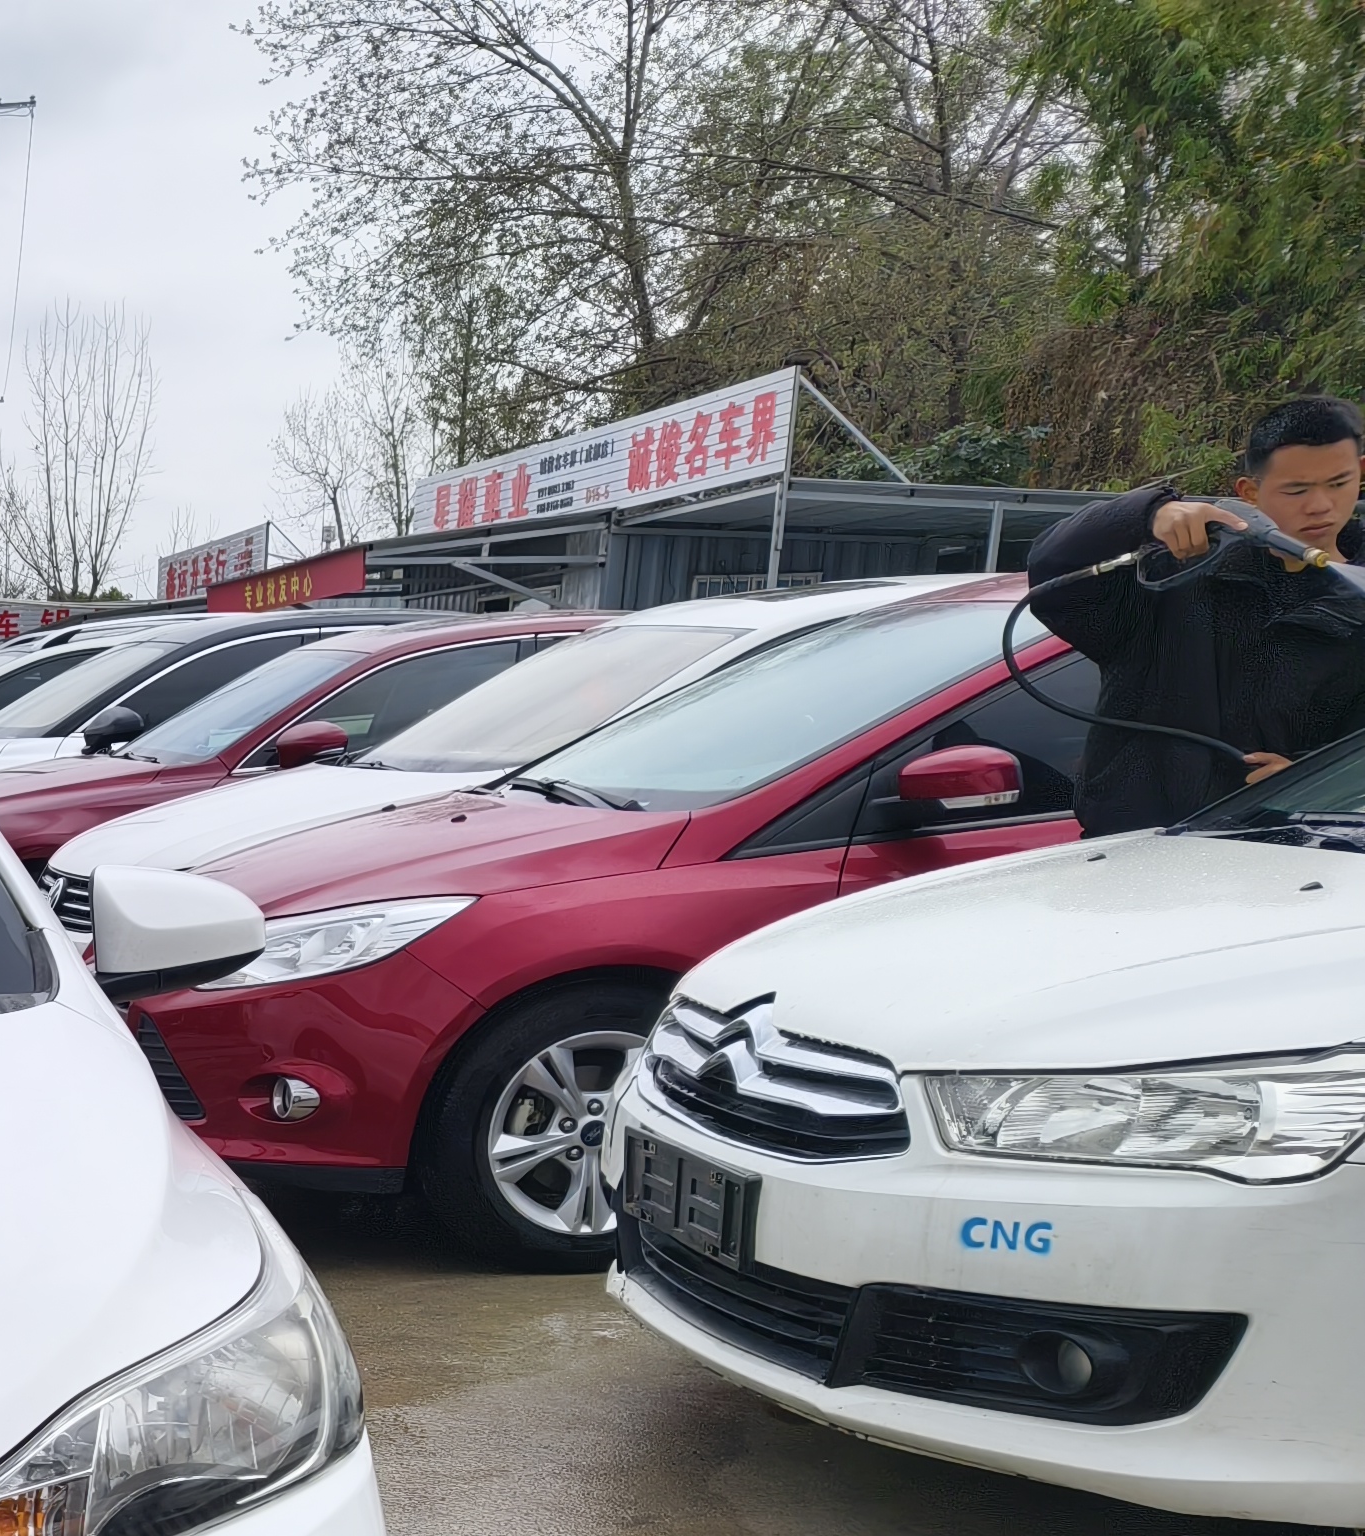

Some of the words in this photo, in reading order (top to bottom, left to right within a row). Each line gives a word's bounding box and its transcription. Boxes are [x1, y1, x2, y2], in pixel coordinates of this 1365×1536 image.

[244, 569, 312, 610] 专业批发中心
[959, 1216, 1054, 1255] CNG
